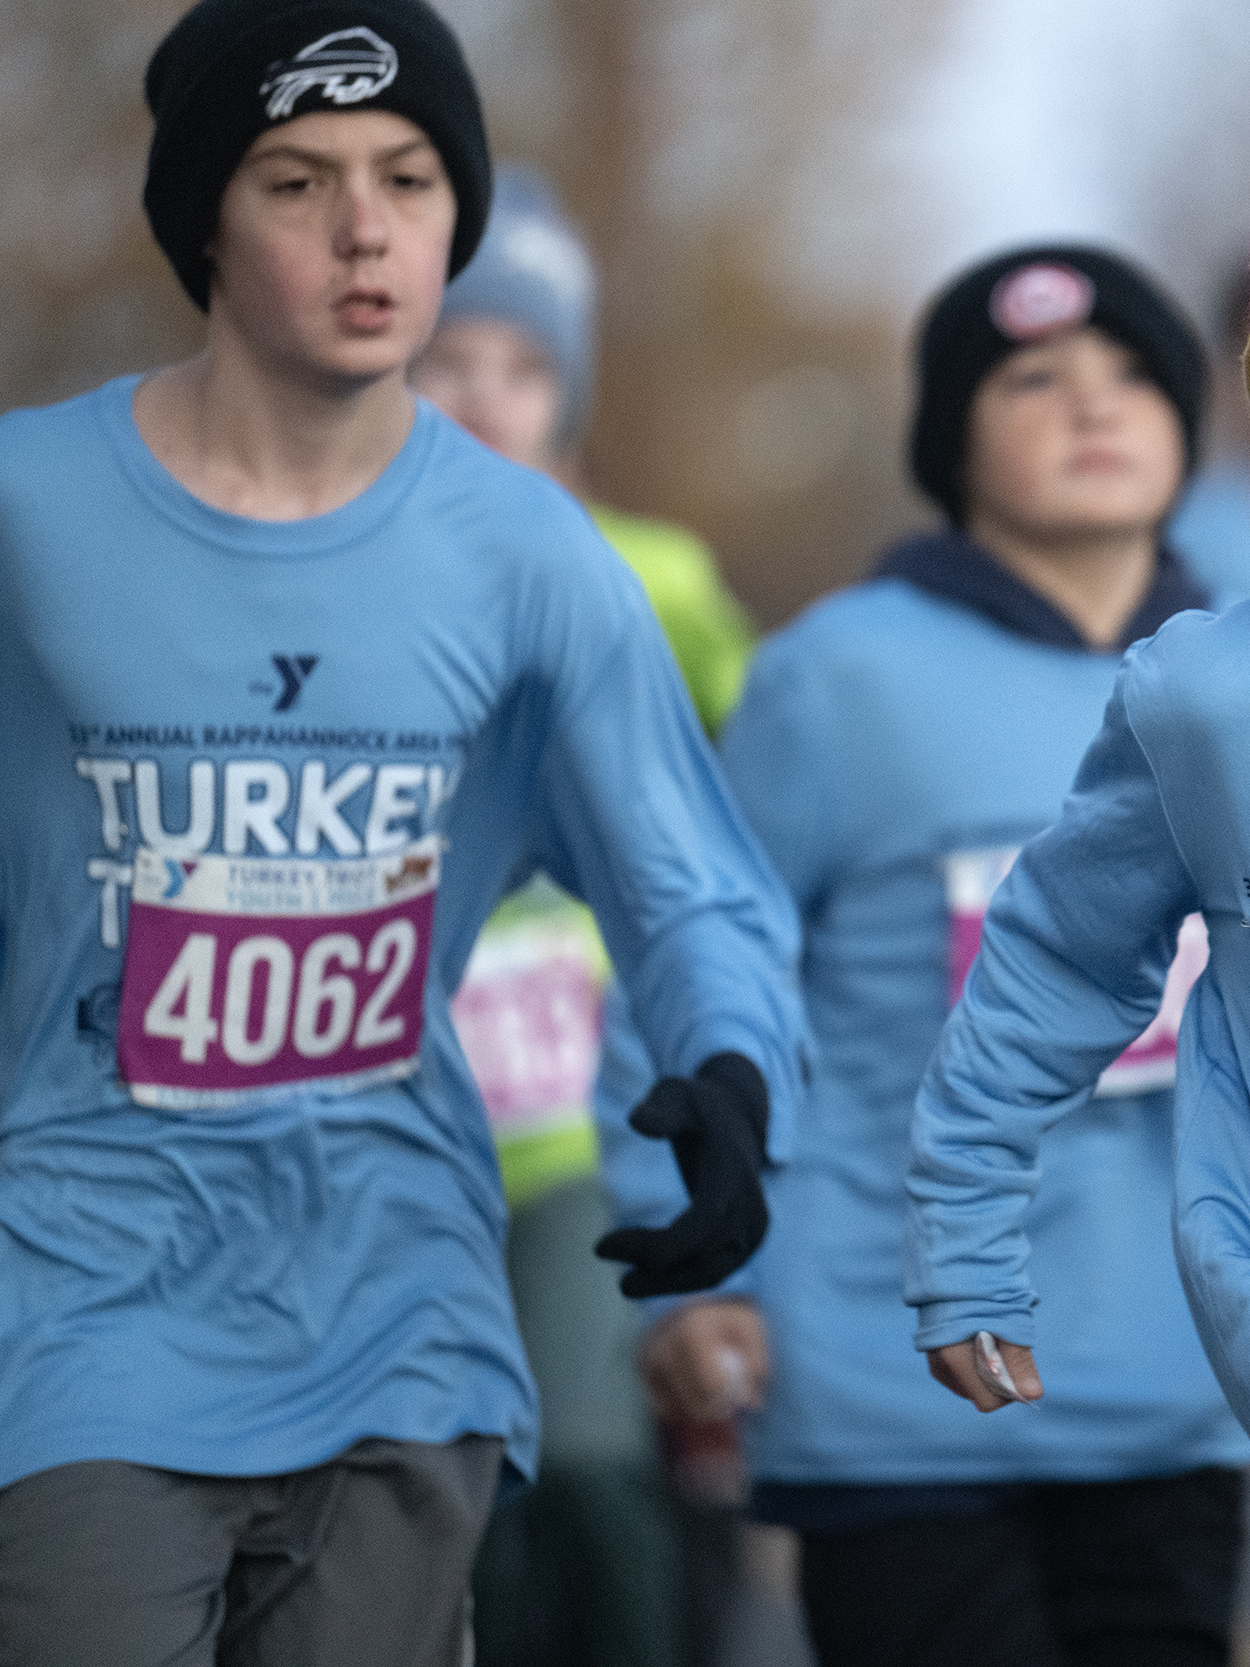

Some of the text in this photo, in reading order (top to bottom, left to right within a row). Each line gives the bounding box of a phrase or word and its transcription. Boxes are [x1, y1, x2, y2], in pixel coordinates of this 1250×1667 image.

[105, 724, 193, 748] ANNUAL
[203, 724, 387, 750] RAPPAHANNOCK
[143, 919, 415, 1066] 4062
